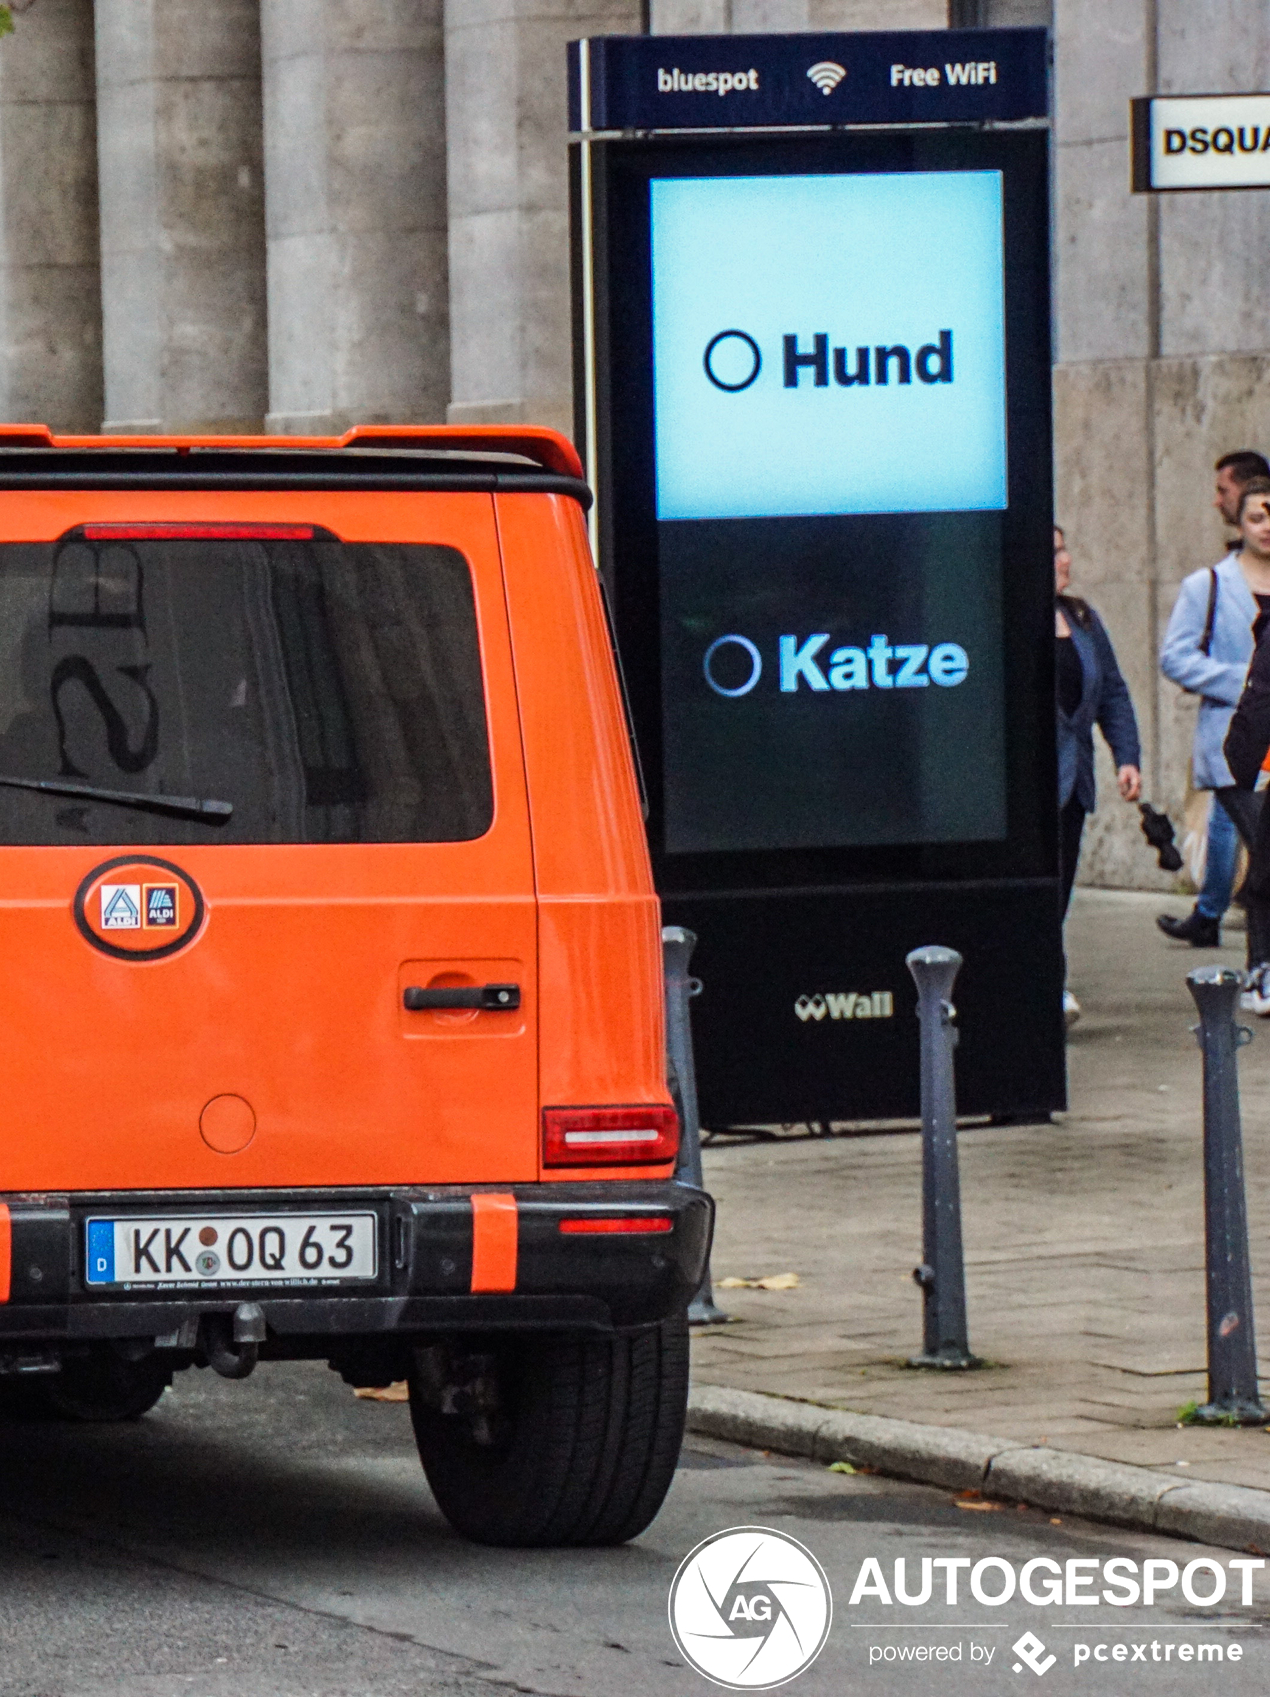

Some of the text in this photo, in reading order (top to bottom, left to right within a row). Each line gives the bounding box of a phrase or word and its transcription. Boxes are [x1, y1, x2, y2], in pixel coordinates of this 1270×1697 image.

[657, 67, 759, 96] bluespot
[890, 61, 997, 87] Free WiFi
[783, 329, 953, 389] Hund
[779, 633, 969, 692] Katze
[108, 916, 137, 926] ALDI
[149, 909, 174, 919] ALDI
[825, 990, 893, 1020] Wall
[133, 1224, 353, 1274] KK OQ 63
[97, 1258, 107, 1271] D
